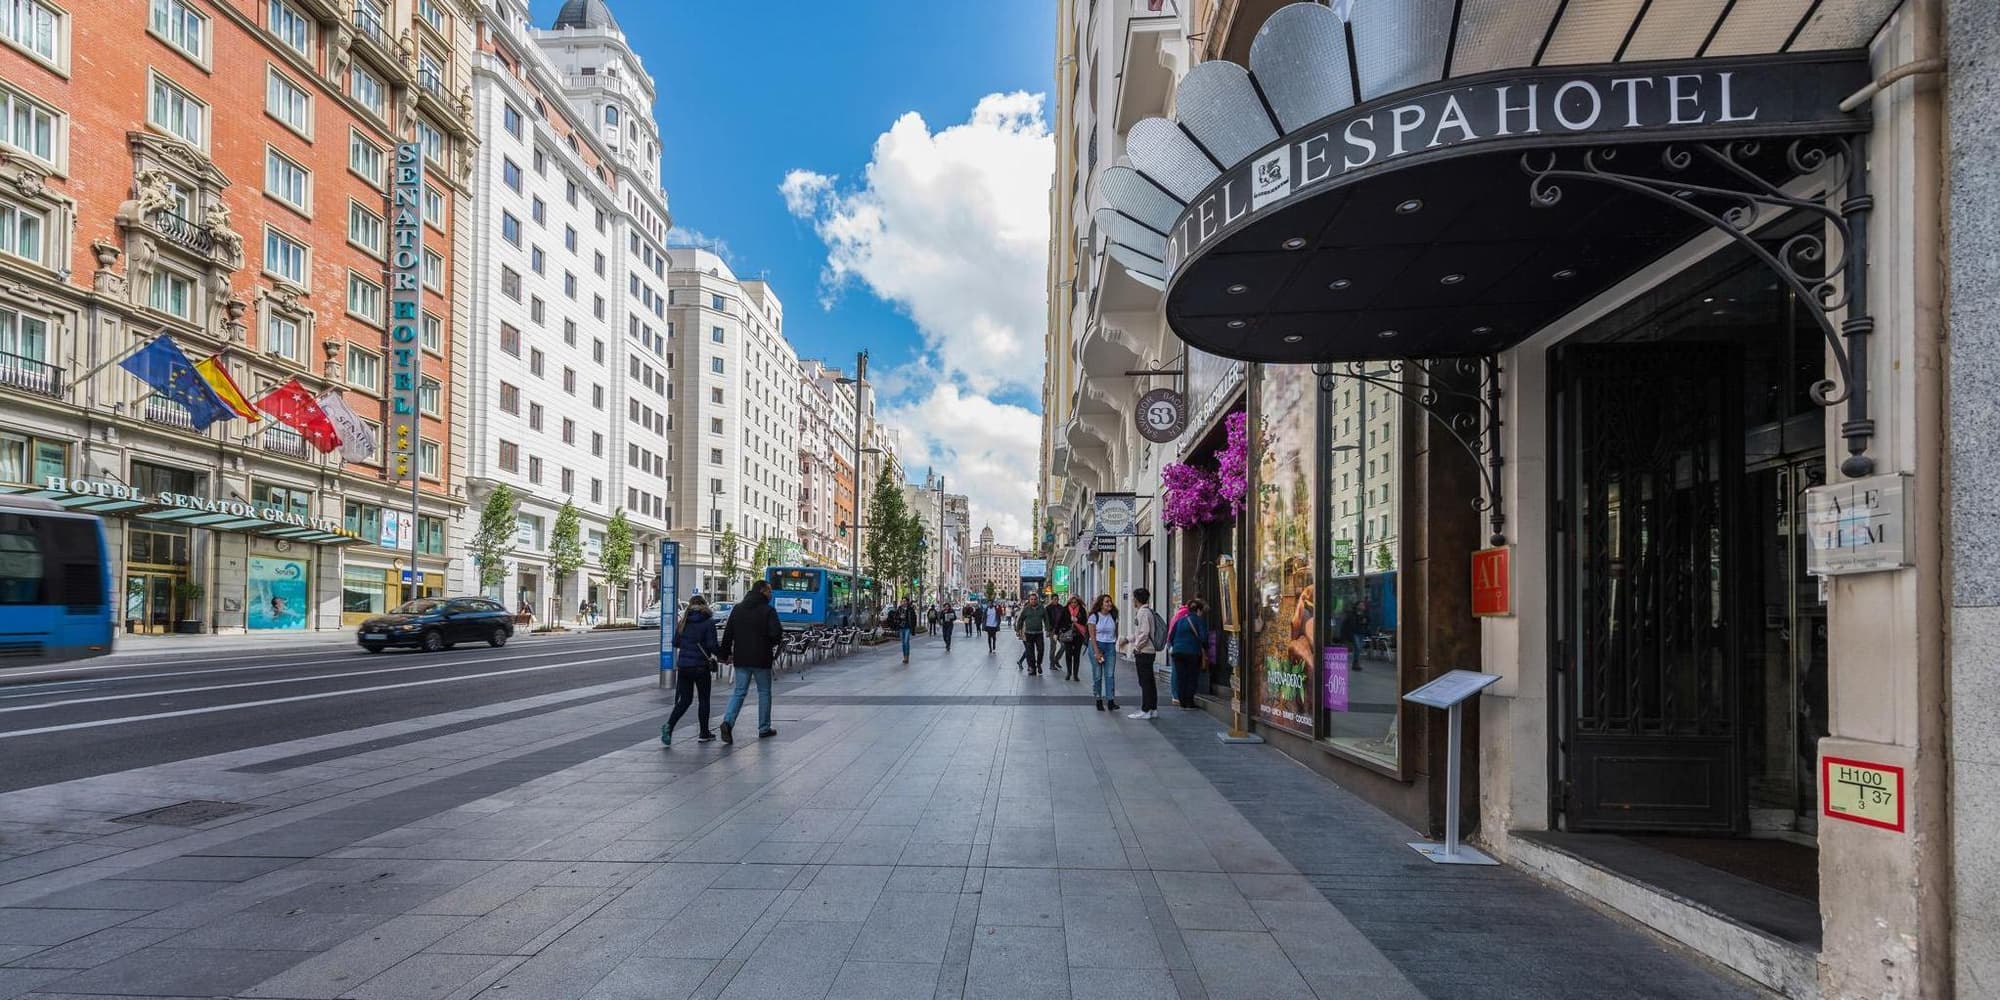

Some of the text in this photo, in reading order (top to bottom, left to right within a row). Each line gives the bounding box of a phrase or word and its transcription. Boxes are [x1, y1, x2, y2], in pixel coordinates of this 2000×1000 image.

[393, 144, 418, 415] SENATOR HOTEL
[46, 475, 145, 502] HOTEL
[159, 491, 258, 519] SENATOR
[262, 508, 305, 527] GRAN
[1828, 489, 1879, 515] A E
[1863, 524, 1884, 545] M
[1477, 554, 1505, 590] AT
[1840, 766, 1883, 786] H100
[1857, 800, 1866, 810] 3
[1872, 790, 1893, 806] 37
